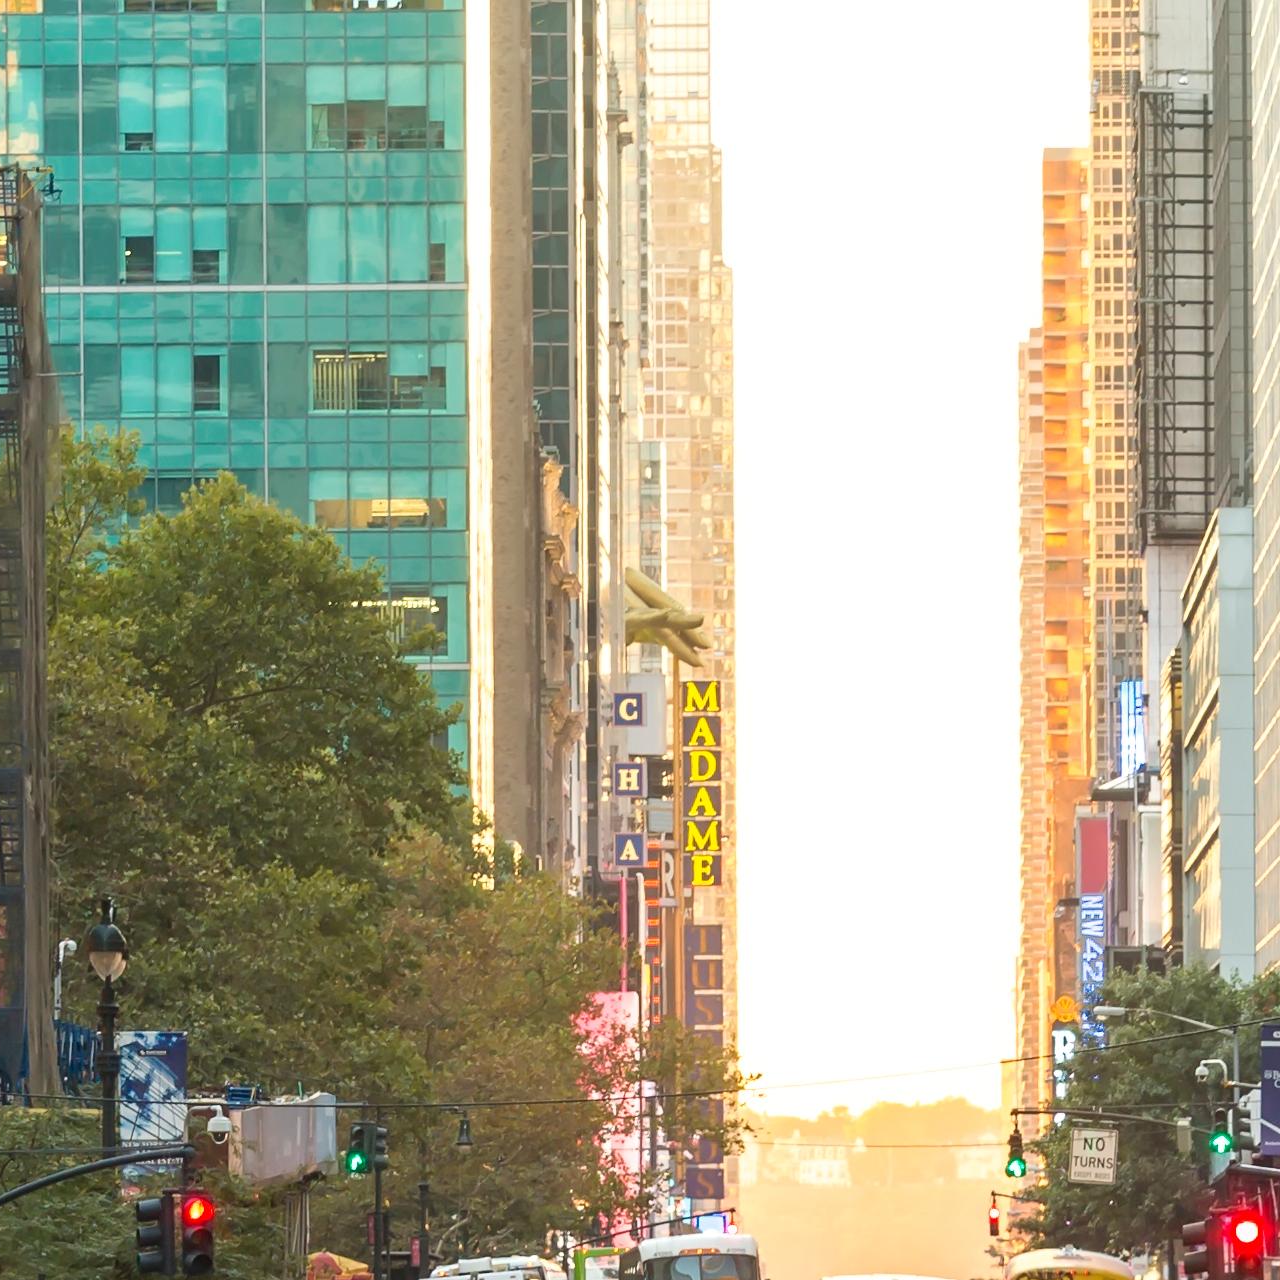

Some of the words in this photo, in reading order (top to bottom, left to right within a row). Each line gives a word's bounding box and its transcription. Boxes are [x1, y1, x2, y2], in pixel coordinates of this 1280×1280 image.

[684, 680, 720, 887] MADAME
[1081, 896, 1105, 938] NEW
[1083, 1138, 1106, 1152] NO
[1074, 1156, 1114, 1170] TURNS
